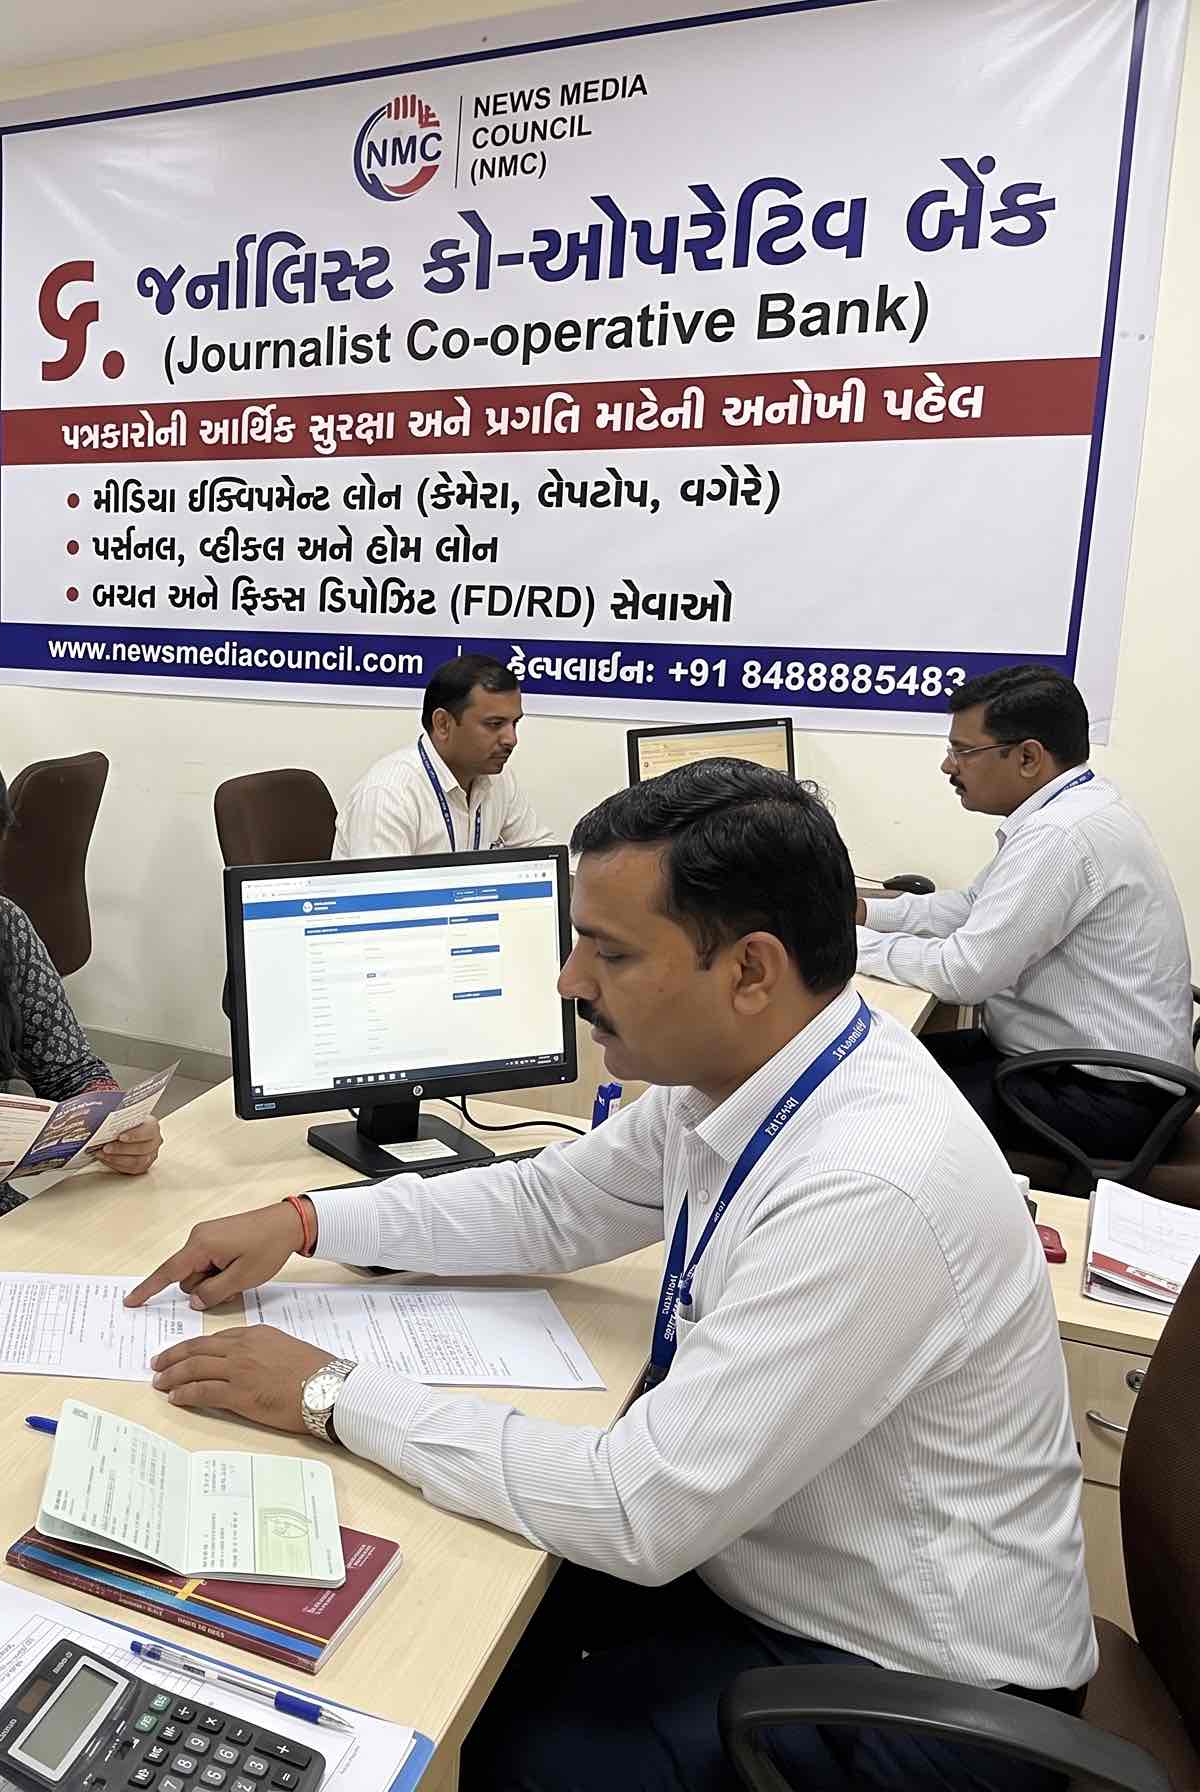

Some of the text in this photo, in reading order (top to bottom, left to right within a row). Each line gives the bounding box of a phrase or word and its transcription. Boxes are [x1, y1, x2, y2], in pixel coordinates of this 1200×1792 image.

[474, 74, 647, 118] NEWS MEDIA
[366, 132, 443, 170] NMC
[473, 114, 591, 148] COUNCIL
[471, 151, 546, 186] (NMC)
[907, 156, 1056, 252] બેંક
[165, 281, 928, 384] (Journalist Co-operative Bank)
[62, 373, 984, 454] પત્રકારોની આર્થિક સુરક્ષા અને પ્રગતિ માટેની અનોખી પહેલ
[94, 479, 175, 513] મીડિયા
[343, 473, 401, 510] લોન
[418, 471, 519, 517] (કેમેરા,
[538, 467, 659, 514] લેપટોપ,
[680, 464, 779, 514] વગેરે)
[93, 526, 184, 567] પર્સનલ,
[298, 525, 352, 562] અને
[367, 525, 421, 564] હોમ
[436, 525, 498, 562] લોન
[93, 585, 155, 608] બચત
[168, 575, 217, 610] અને
[451, 584, 594, 627] (FD/RD)
[611, 579, 732, 622] સેવાઓ
[49, 641, 422, 673] www.newsmediacouncil.com
[669, 659, 726, 687] +91
[742, 661, 965, 696] 8488885483
